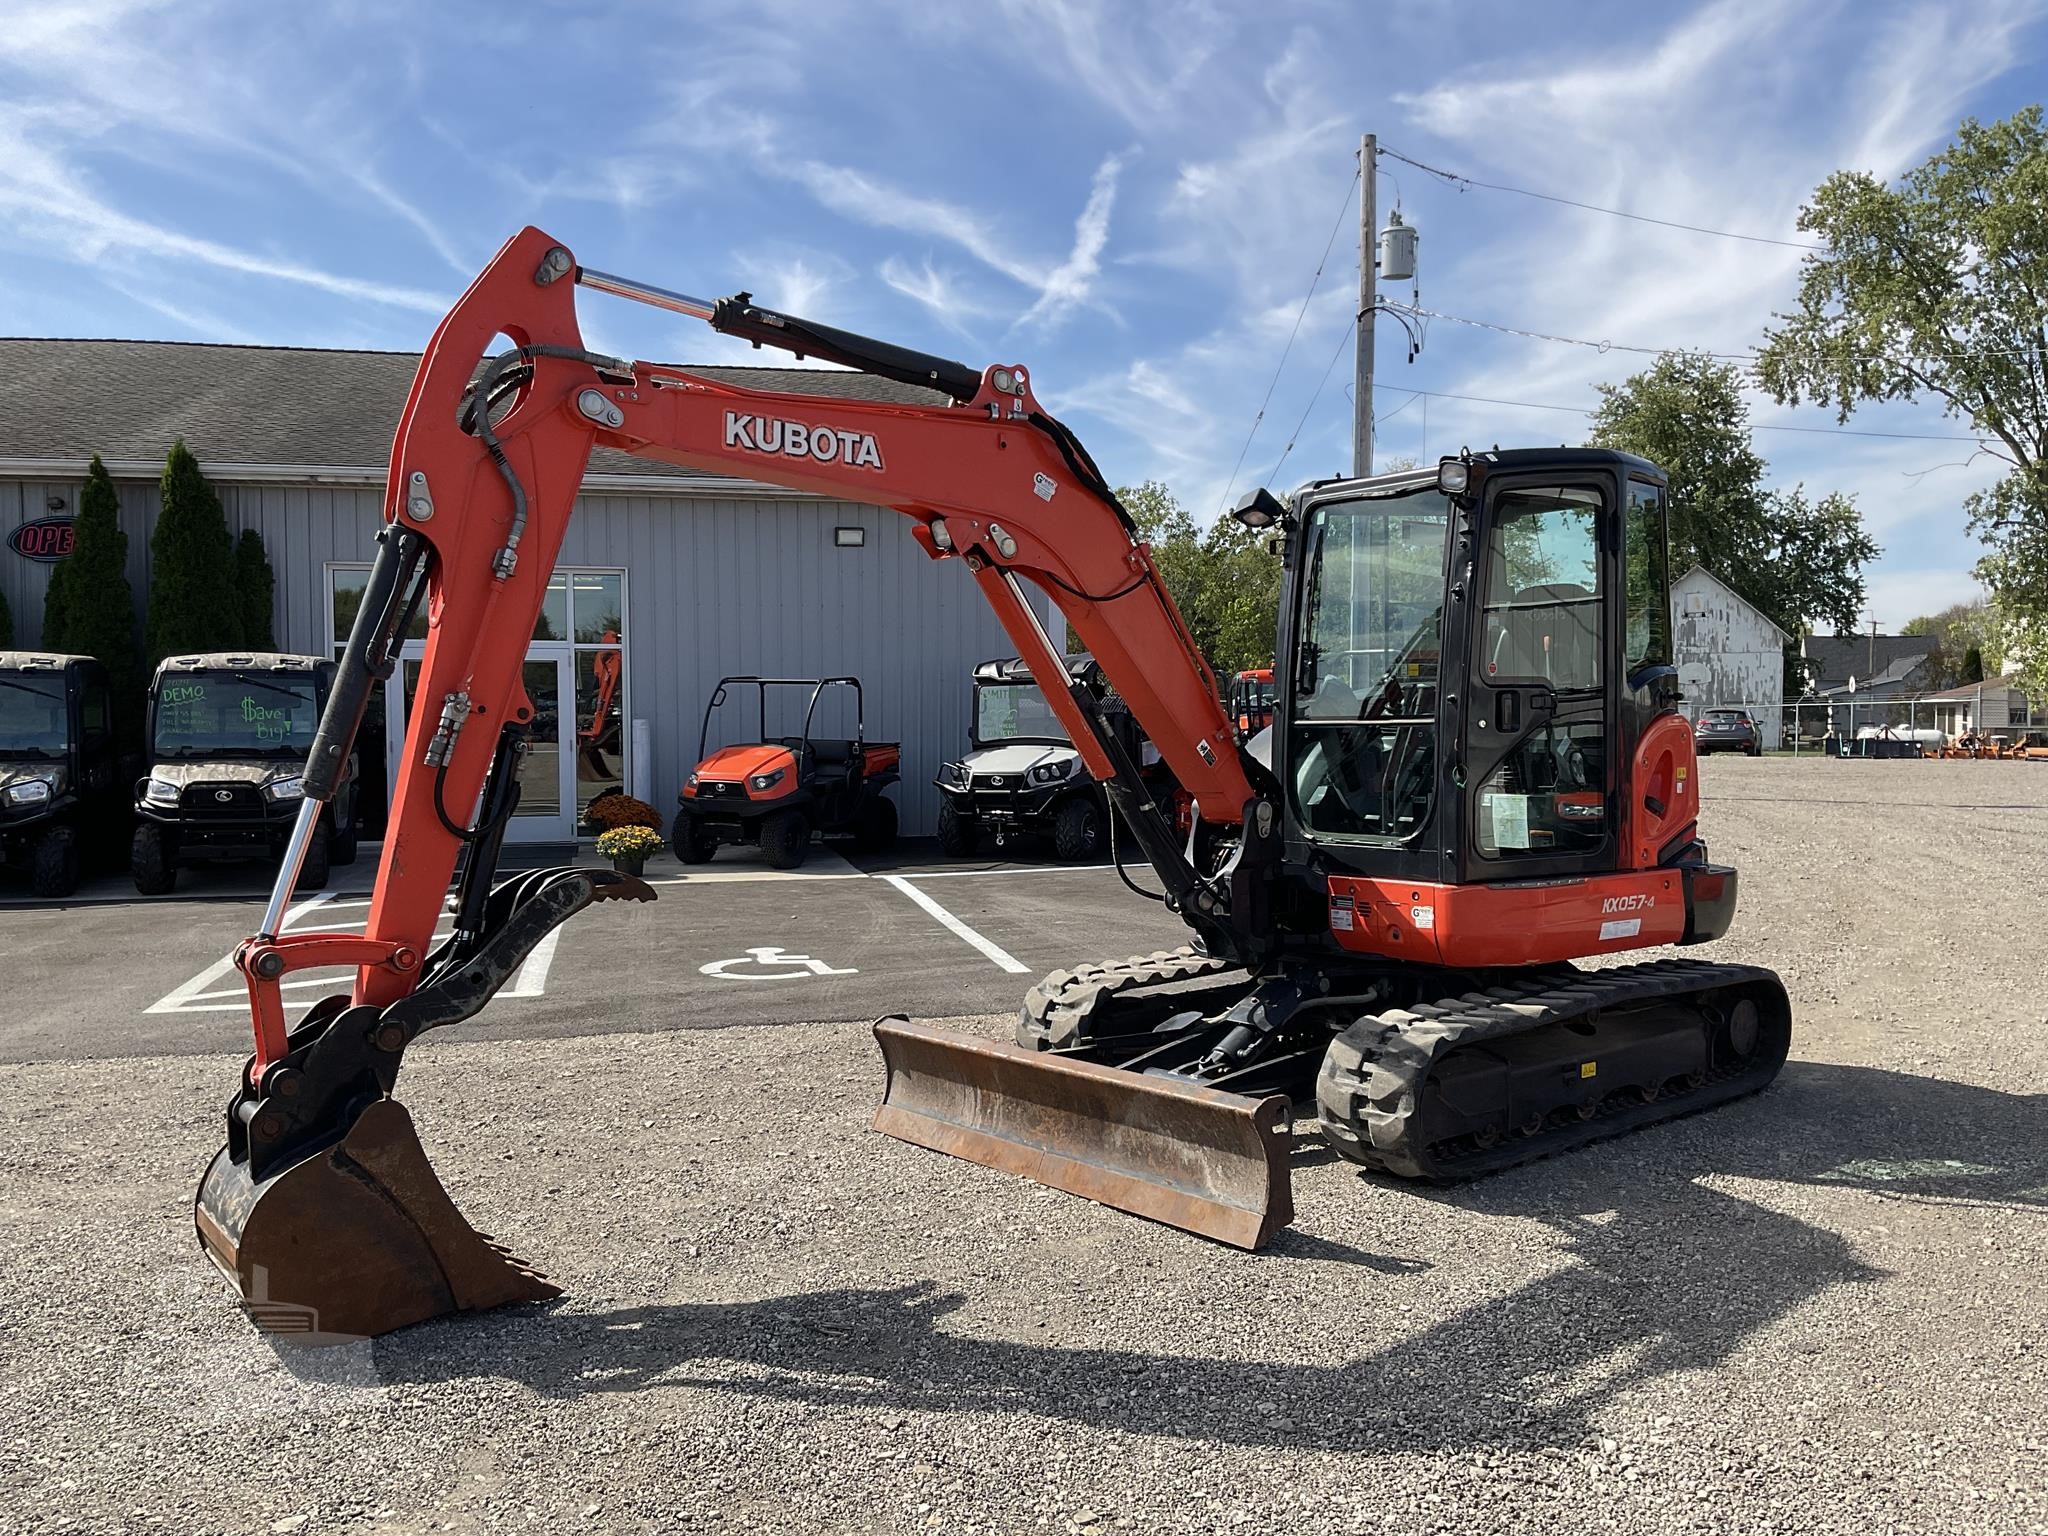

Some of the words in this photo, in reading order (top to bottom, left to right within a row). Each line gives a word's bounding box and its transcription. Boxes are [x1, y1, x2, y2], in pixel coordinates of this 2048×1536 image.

[725, 411, 882, 468] KUBOTA
[20, 526, 76, 554] OPE
[163, 685, 204, 702] DEMO
[241, 696, 282, 723] $ave
[1601, 894, 1655, 914] KX057-4
